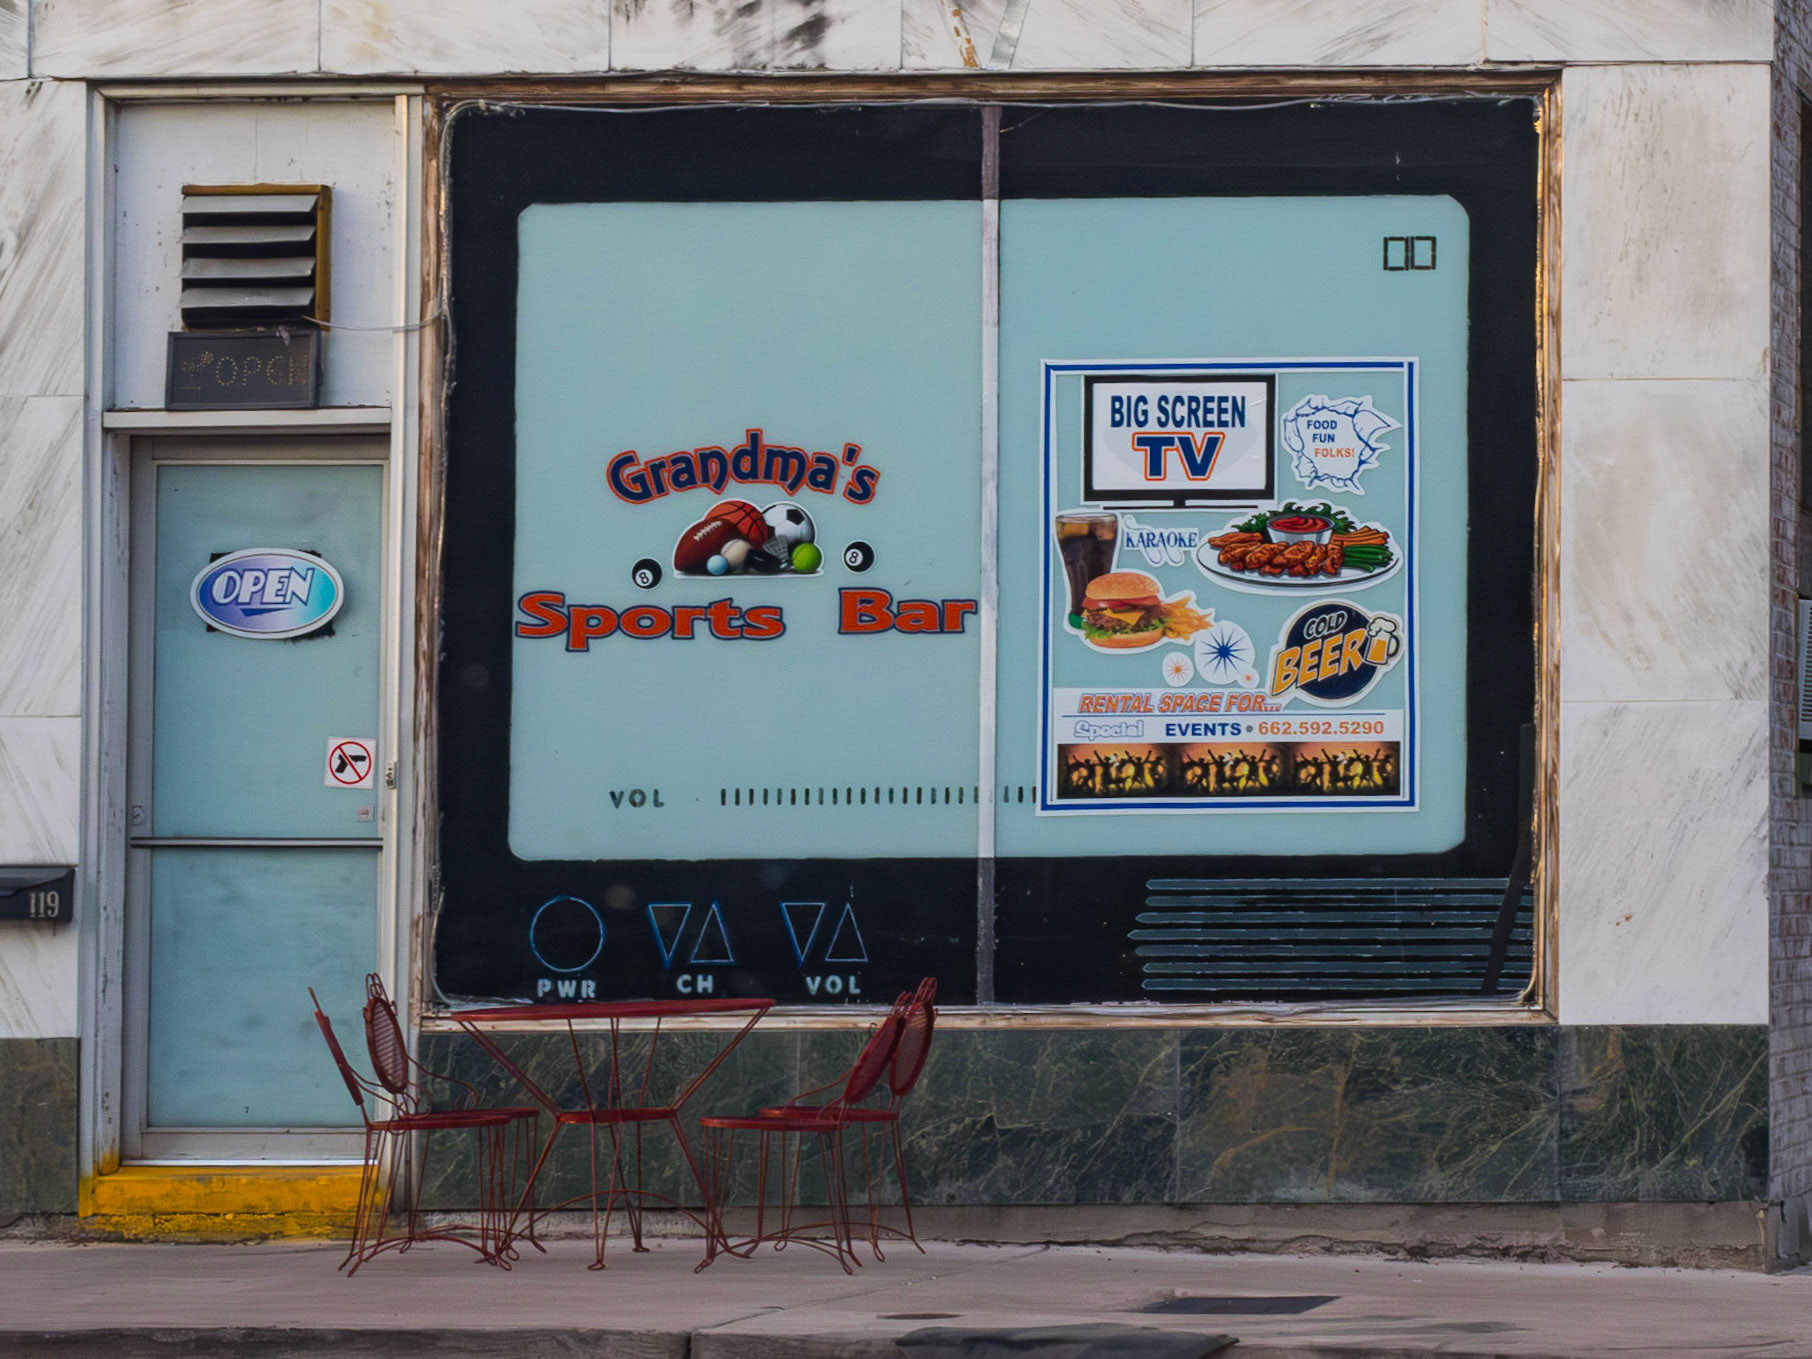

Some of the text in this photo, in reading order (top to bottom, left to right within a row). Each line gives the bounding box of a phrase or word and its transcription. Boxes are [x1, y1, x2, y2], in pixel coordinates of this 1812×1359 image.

[215, 355, 309, 386] OPEN
[1110, 395, 1246, 428] BIG SCREEN
[1307, 420, 1338, 430] FOOD
[1312, 433, 1335, 443] FUN
[1132, 431, 1226, 481] TV
[1314, 447, 1355, 458] FOLKS!
[606, 428, 880, 505] Grandma's
[1125, 531, 1198, 549] KARAOKE
[211, 567, 315, 606] OPEN
[638, 571, 650, 586] 8
[515, 587, 978, 652] Sports Bar
[1304, 611, 1348, 640] COLD
[1271, 628, 1367, 697] BEER
[1079, 692, 1282, 714] RENTAL SPACE FOR...
[1073, 720, 1385, 742] Special EVENTS 662.592.5290
[609, 788, 665, 808] VOL
[29, 890, 60, 918] 119
[537, 979, 597, 999] PWR
[676, 974, 714, 994] CH
[806, 974, 861, 995] VOL
